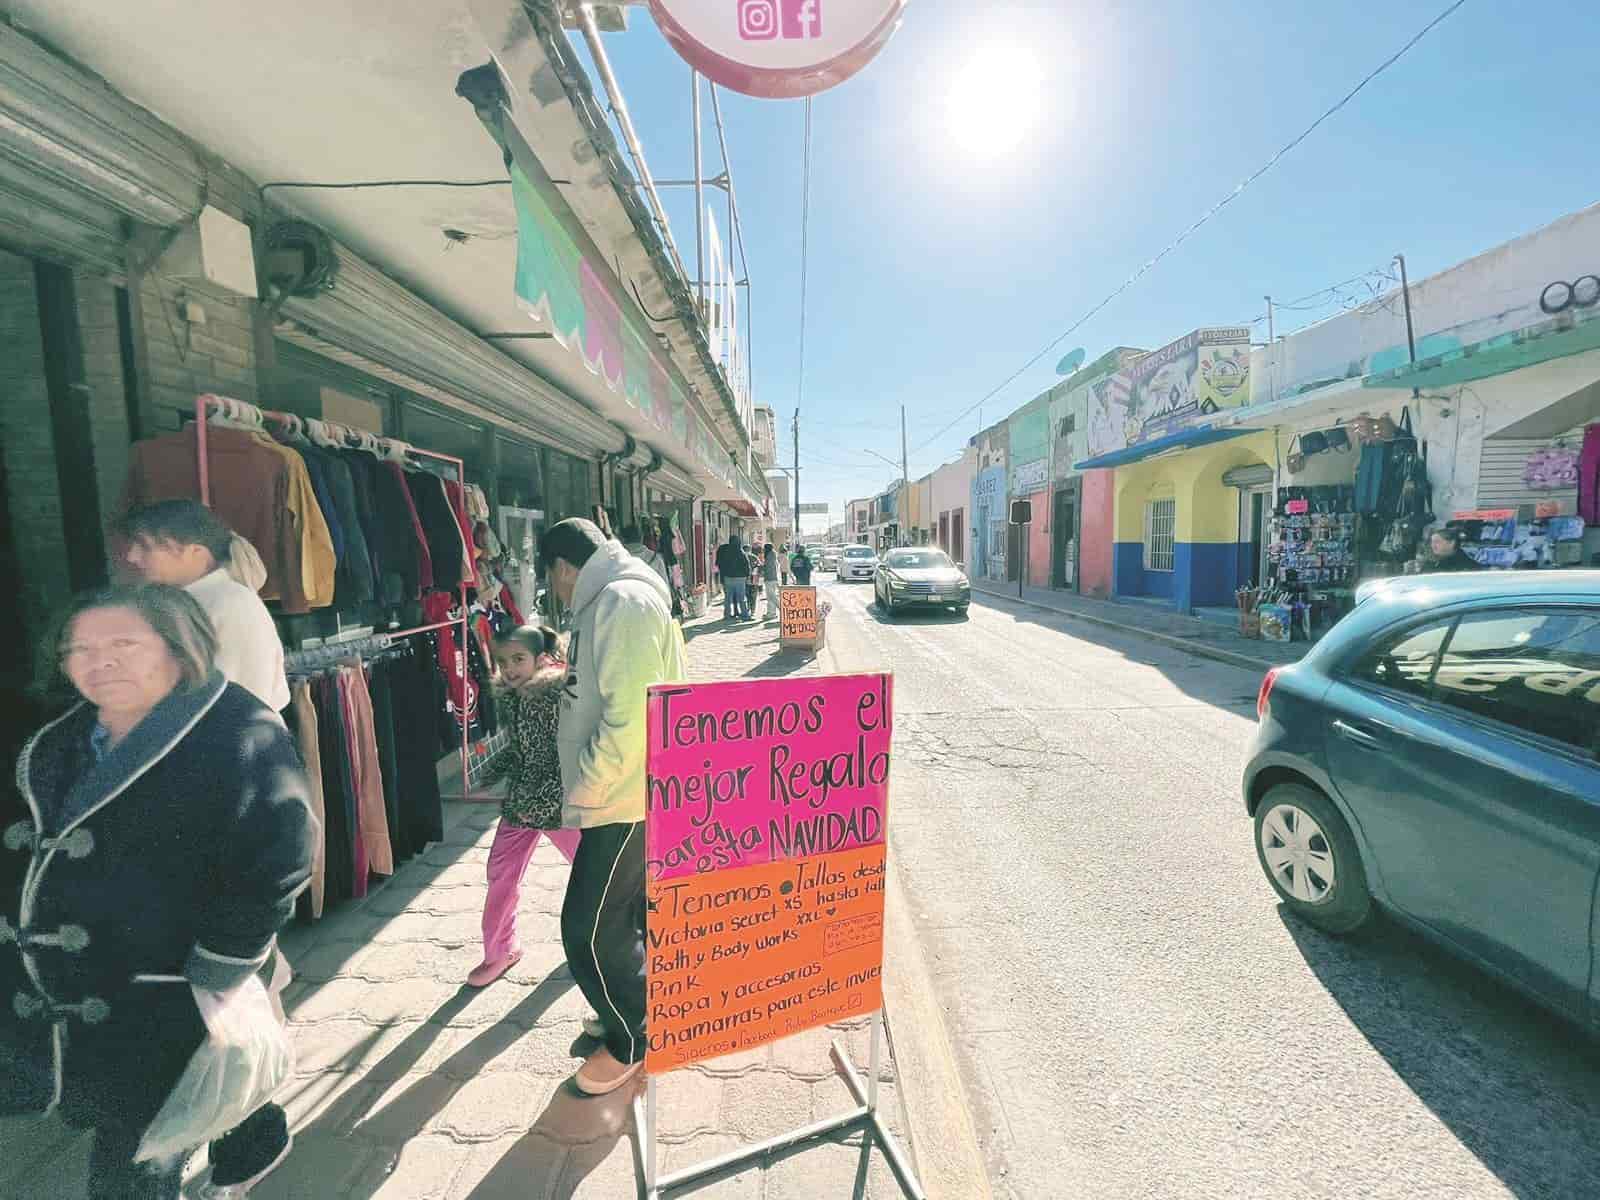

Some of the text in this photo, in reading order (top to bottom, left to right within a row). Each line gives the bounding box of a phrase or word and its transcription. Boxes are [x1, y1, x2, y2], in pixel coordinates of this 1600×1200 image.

[648, 674, 887, 749] Tenemos el
[647, 735, 889, 827] mejor Regalo
[697, 826, 762, 874] esta
[769, 806, 881, 861] NAVIDAD
[796, 861, 846, 893] Tallas
[816, 886, 858, 906] hasta
[664, 883, 771, 918] Tenemos
[649, 921, 724, 949] Victoria
[652, 948, 690, 974] Bath
[695, 953, 705, 969] y
[711, 941, 750, 961] Body
[653, 962, 822, 1023] Ropa y accesorios
[768, 992, 802, 1019] para
[808, 977, 840, 1000] este
